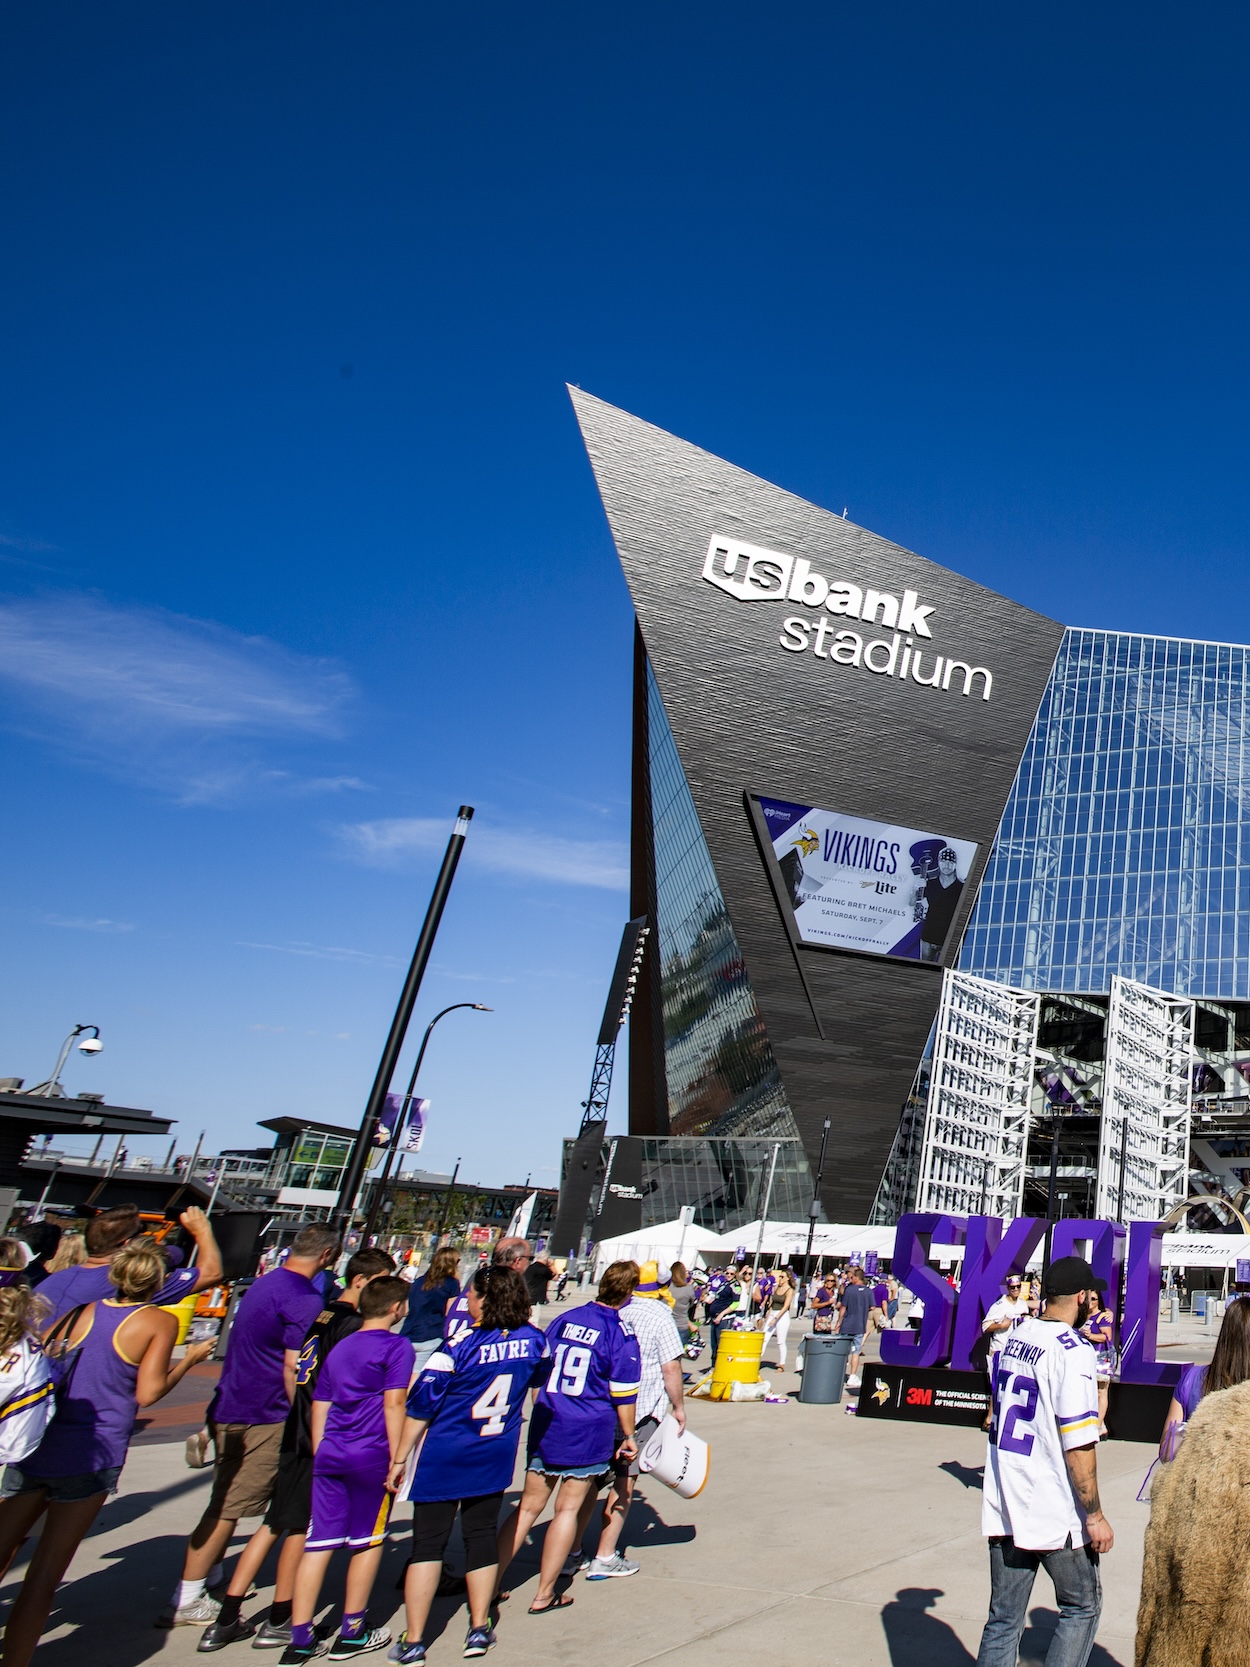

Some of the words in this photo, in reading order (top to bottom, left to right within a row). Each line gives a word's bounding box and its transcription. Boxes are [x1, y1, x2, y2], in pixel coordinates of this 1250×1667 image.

[779, 617, 993, 700] stadium
[823, 829, 900, 875] VIKINGS
[875, 881, 897, 894] Lite
[802, 893, 846, 906] FEATURING
[847, 902, 867, 910] BRET
[868, 905, 906, 917] MICHAELS
[821, 909, 858, 921] SATURDAY,
[859, 916, 878, 924] SEPT.
[807, 928, 889, 946] VIKINGS.COM/KICKOFFRALLY
[406, 1123, 424, 1150] SKOL
[617, 1191, 643, 1199] stadium
[879, 1213, 1194, 1383] SKOL
[562, 1323, 600, 1346] THIELEN
[478, 1339, 530, 1365] FAVRE
[546, 1343, 592, 1397] 19
[472, 1374, 513, 1437] 4
[906, 1387, 932, 1406] 3M
[947, 1391, 971, 1400] OFFICIAL
[954, 1401, 986, 1410] MINNESOTA
